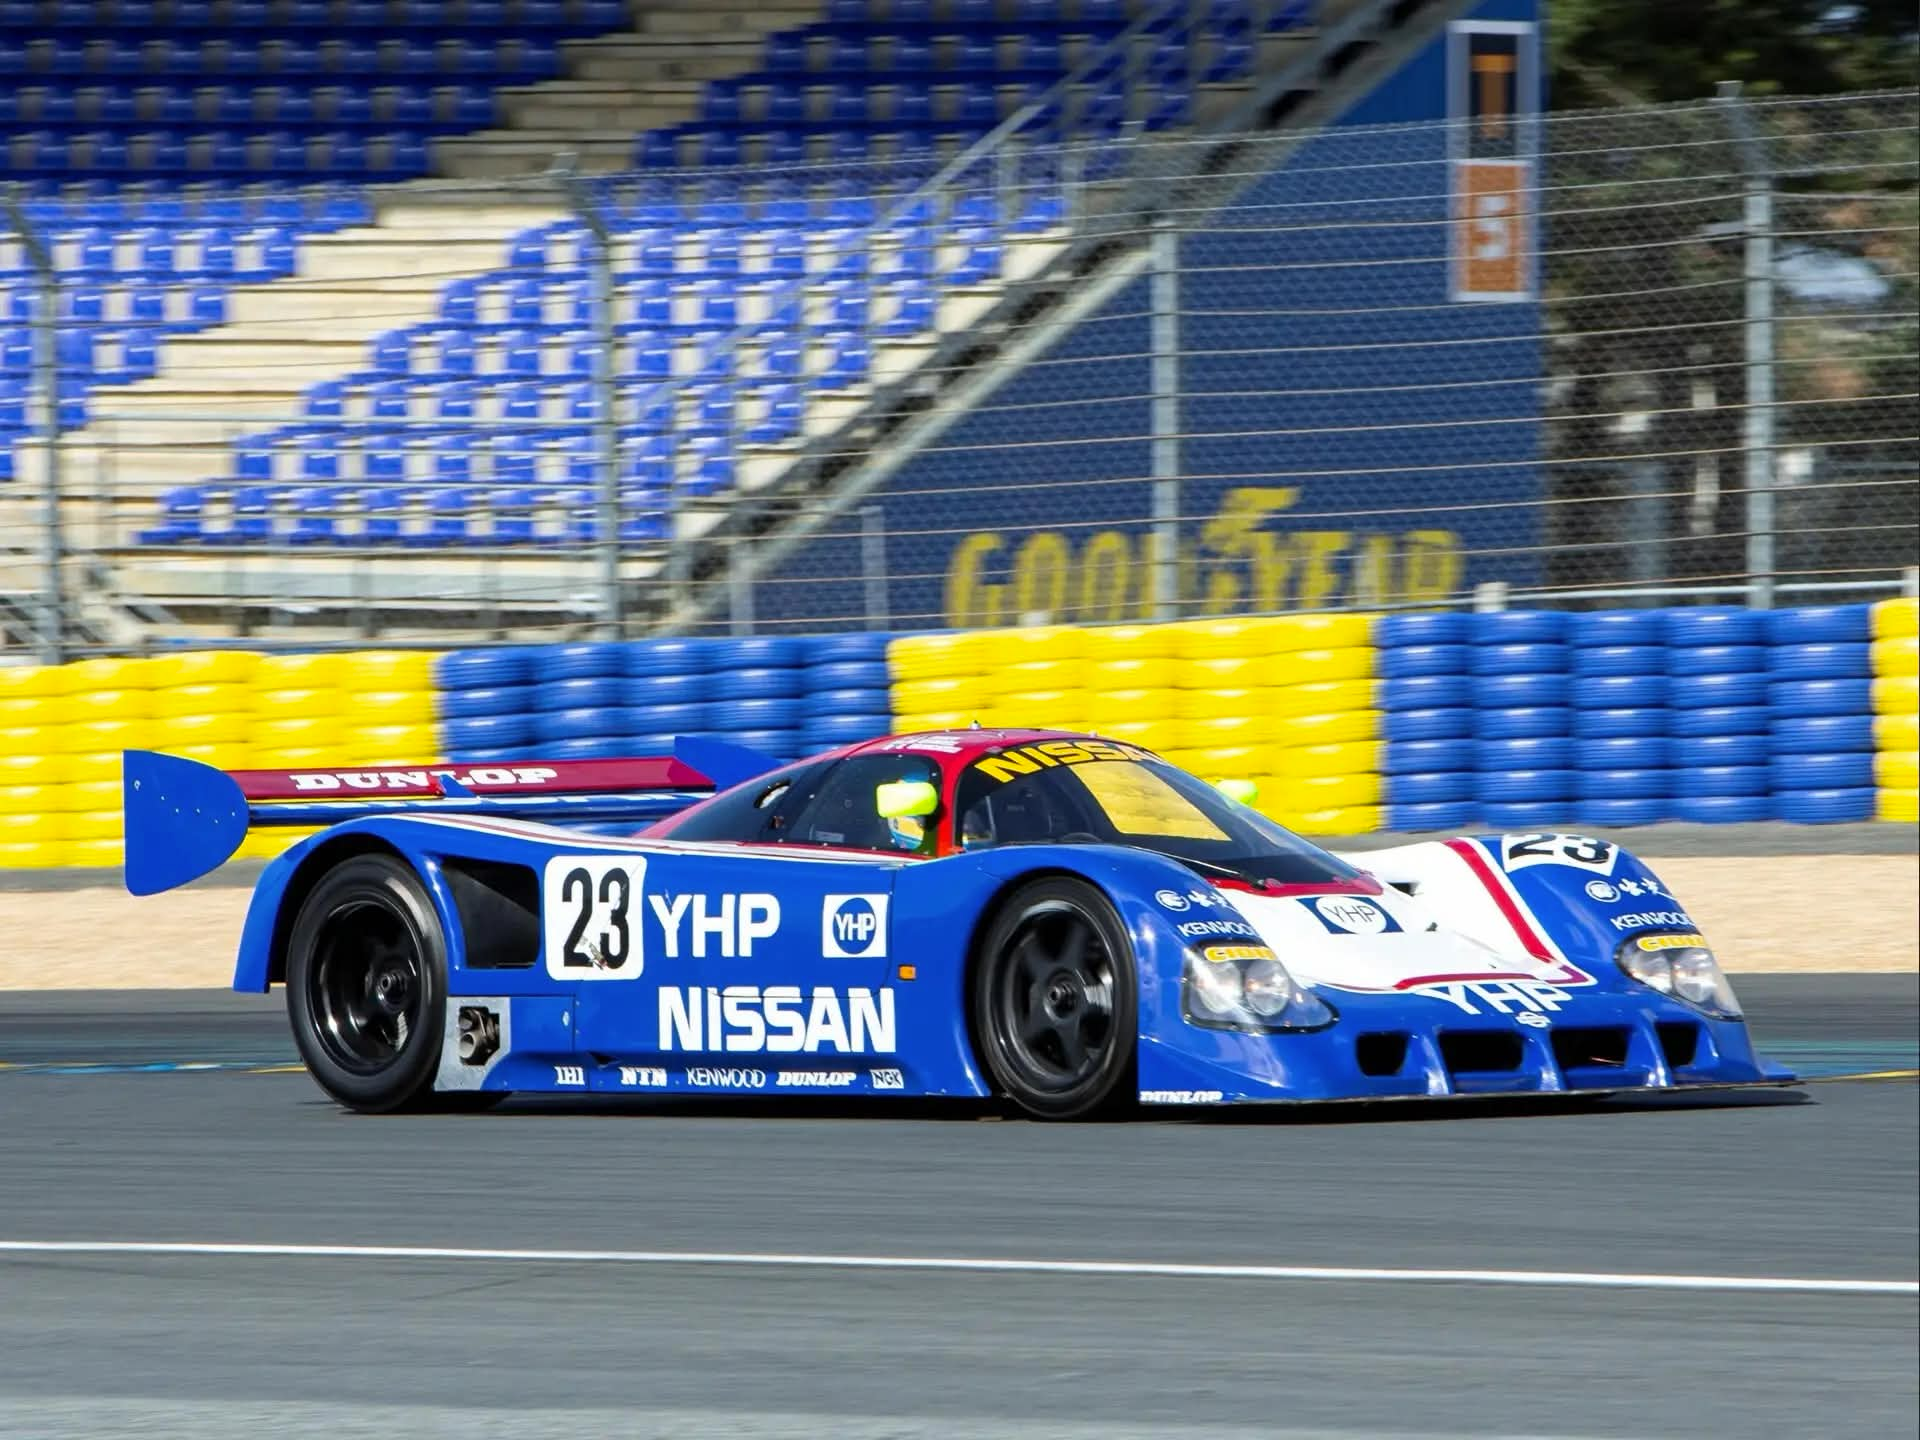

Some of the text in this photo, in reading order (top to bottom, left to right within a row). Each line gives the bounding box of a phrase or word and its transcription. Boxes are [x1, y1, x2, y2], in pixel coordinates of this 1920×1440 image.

[1508, 834, 1613, 864] 23
[562, 867, 630, 970] 23
[648, 894, 781, 957] YHP
[1323, 905, 1376, 923] YHP
[835, 913, 875, 941] YHP
[1177, 921, 1259, 937] KENWOO
[1412, 982, 1573, 1015] YHP
[658, 986, 896, 1053] NISSAN
[619, 1067, 667, 1086] NTN
[686, 1067, 766, 1088] KENWOOD
[776, 1071, 857, 1086] DUNLOP
[872, 1071, 902, 1085] NGK
